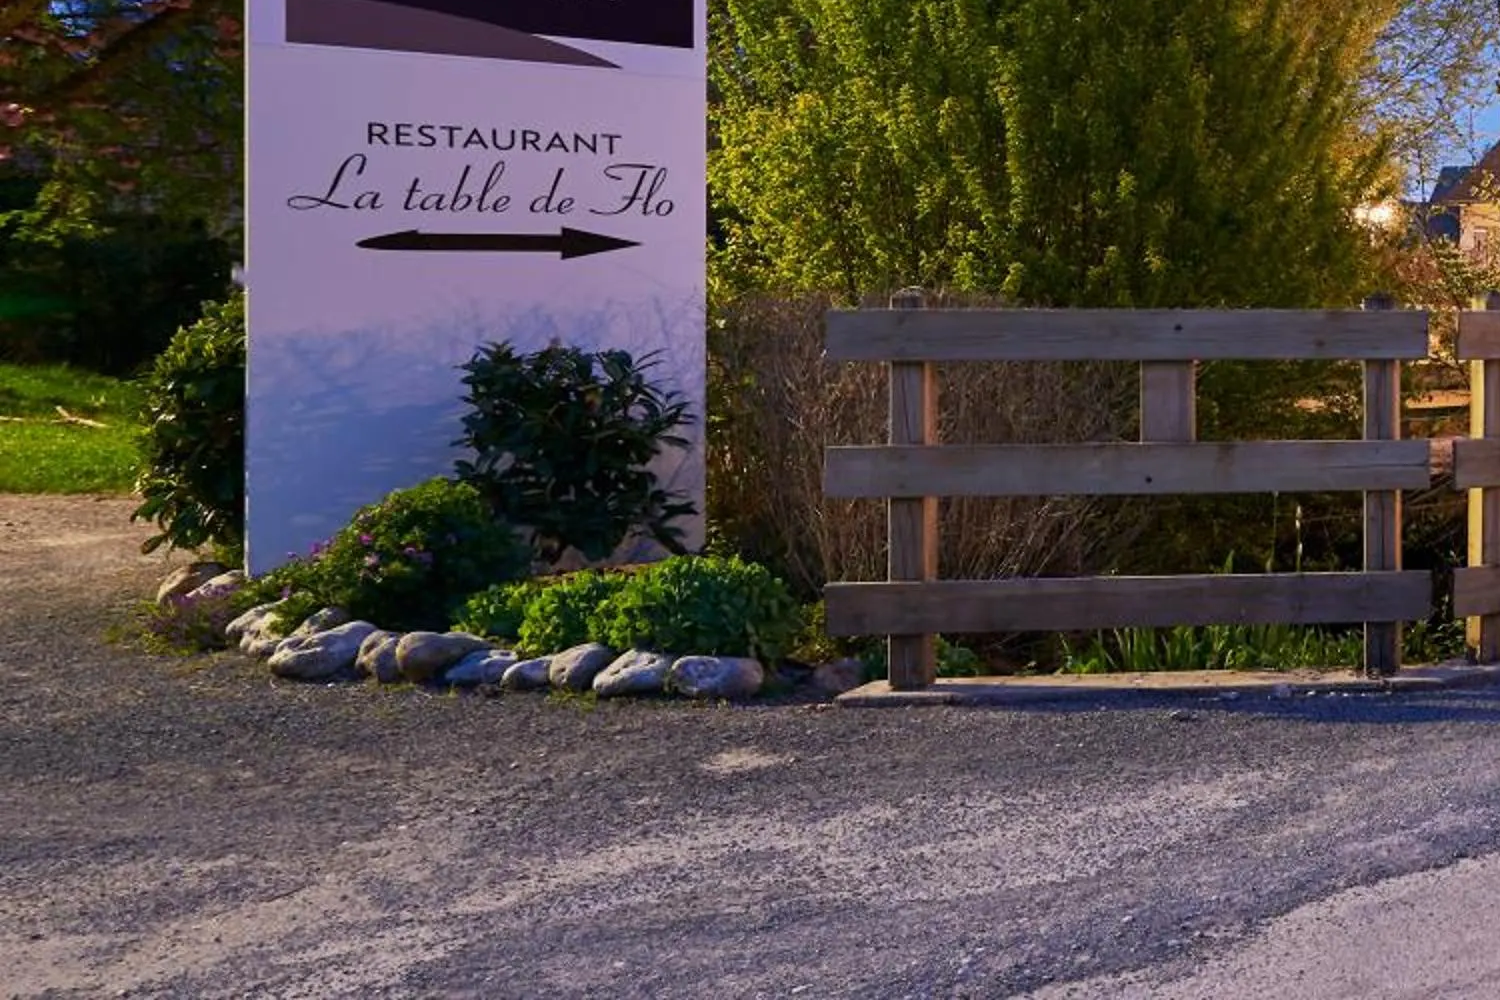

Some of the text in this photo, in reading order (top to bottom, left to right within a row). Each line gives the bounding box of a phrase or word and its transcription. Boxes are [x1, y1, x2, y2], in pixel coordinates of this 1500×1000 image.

[366, 122, 622, 155] RESTAURANT
[287, 153, 674, 217] La table de Flo
